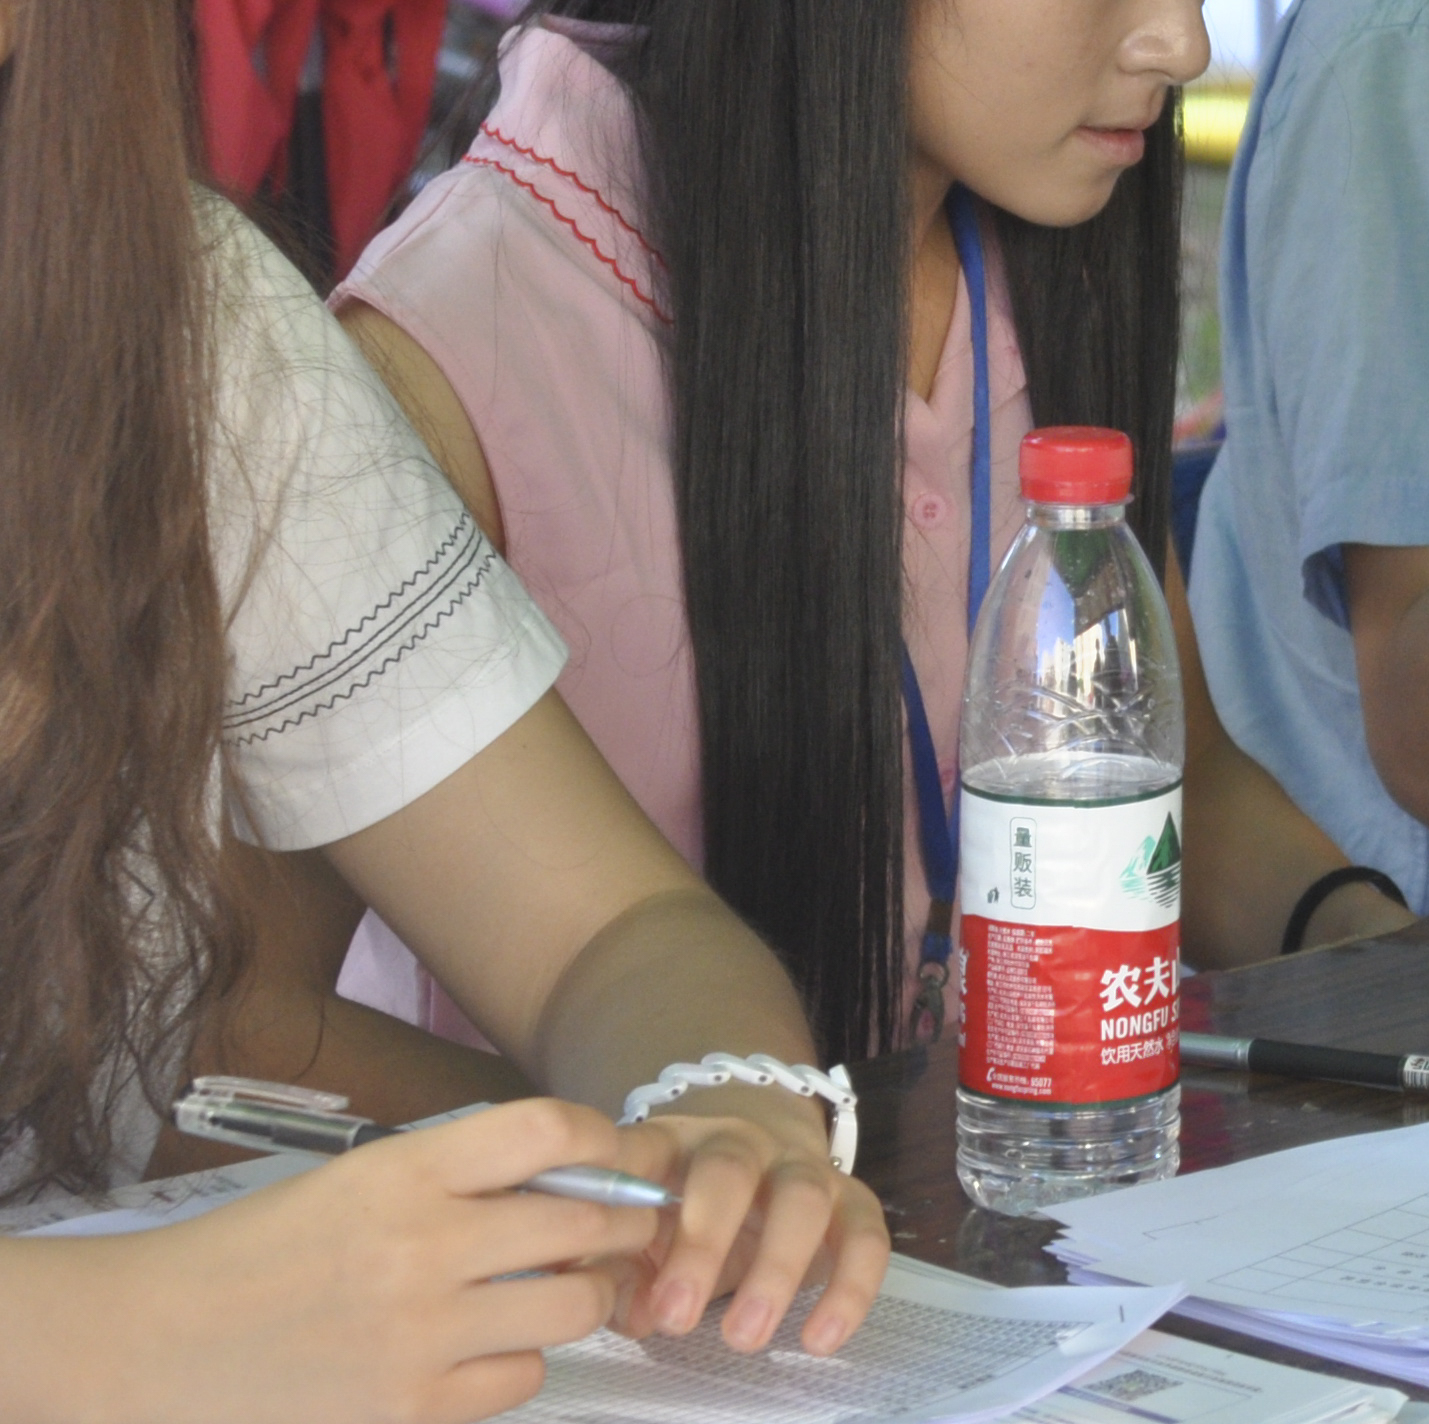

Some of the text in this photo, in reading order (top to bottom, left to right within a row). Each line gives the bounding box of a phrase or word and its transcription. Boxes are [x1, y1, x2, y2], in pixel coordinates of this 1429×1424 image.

[1013, 827, 1033, 898] 量贩装
[1100, 1006, 1168, 1042] NONGFU
[1100, 1036, 1164, 1065] 饮用天然水
